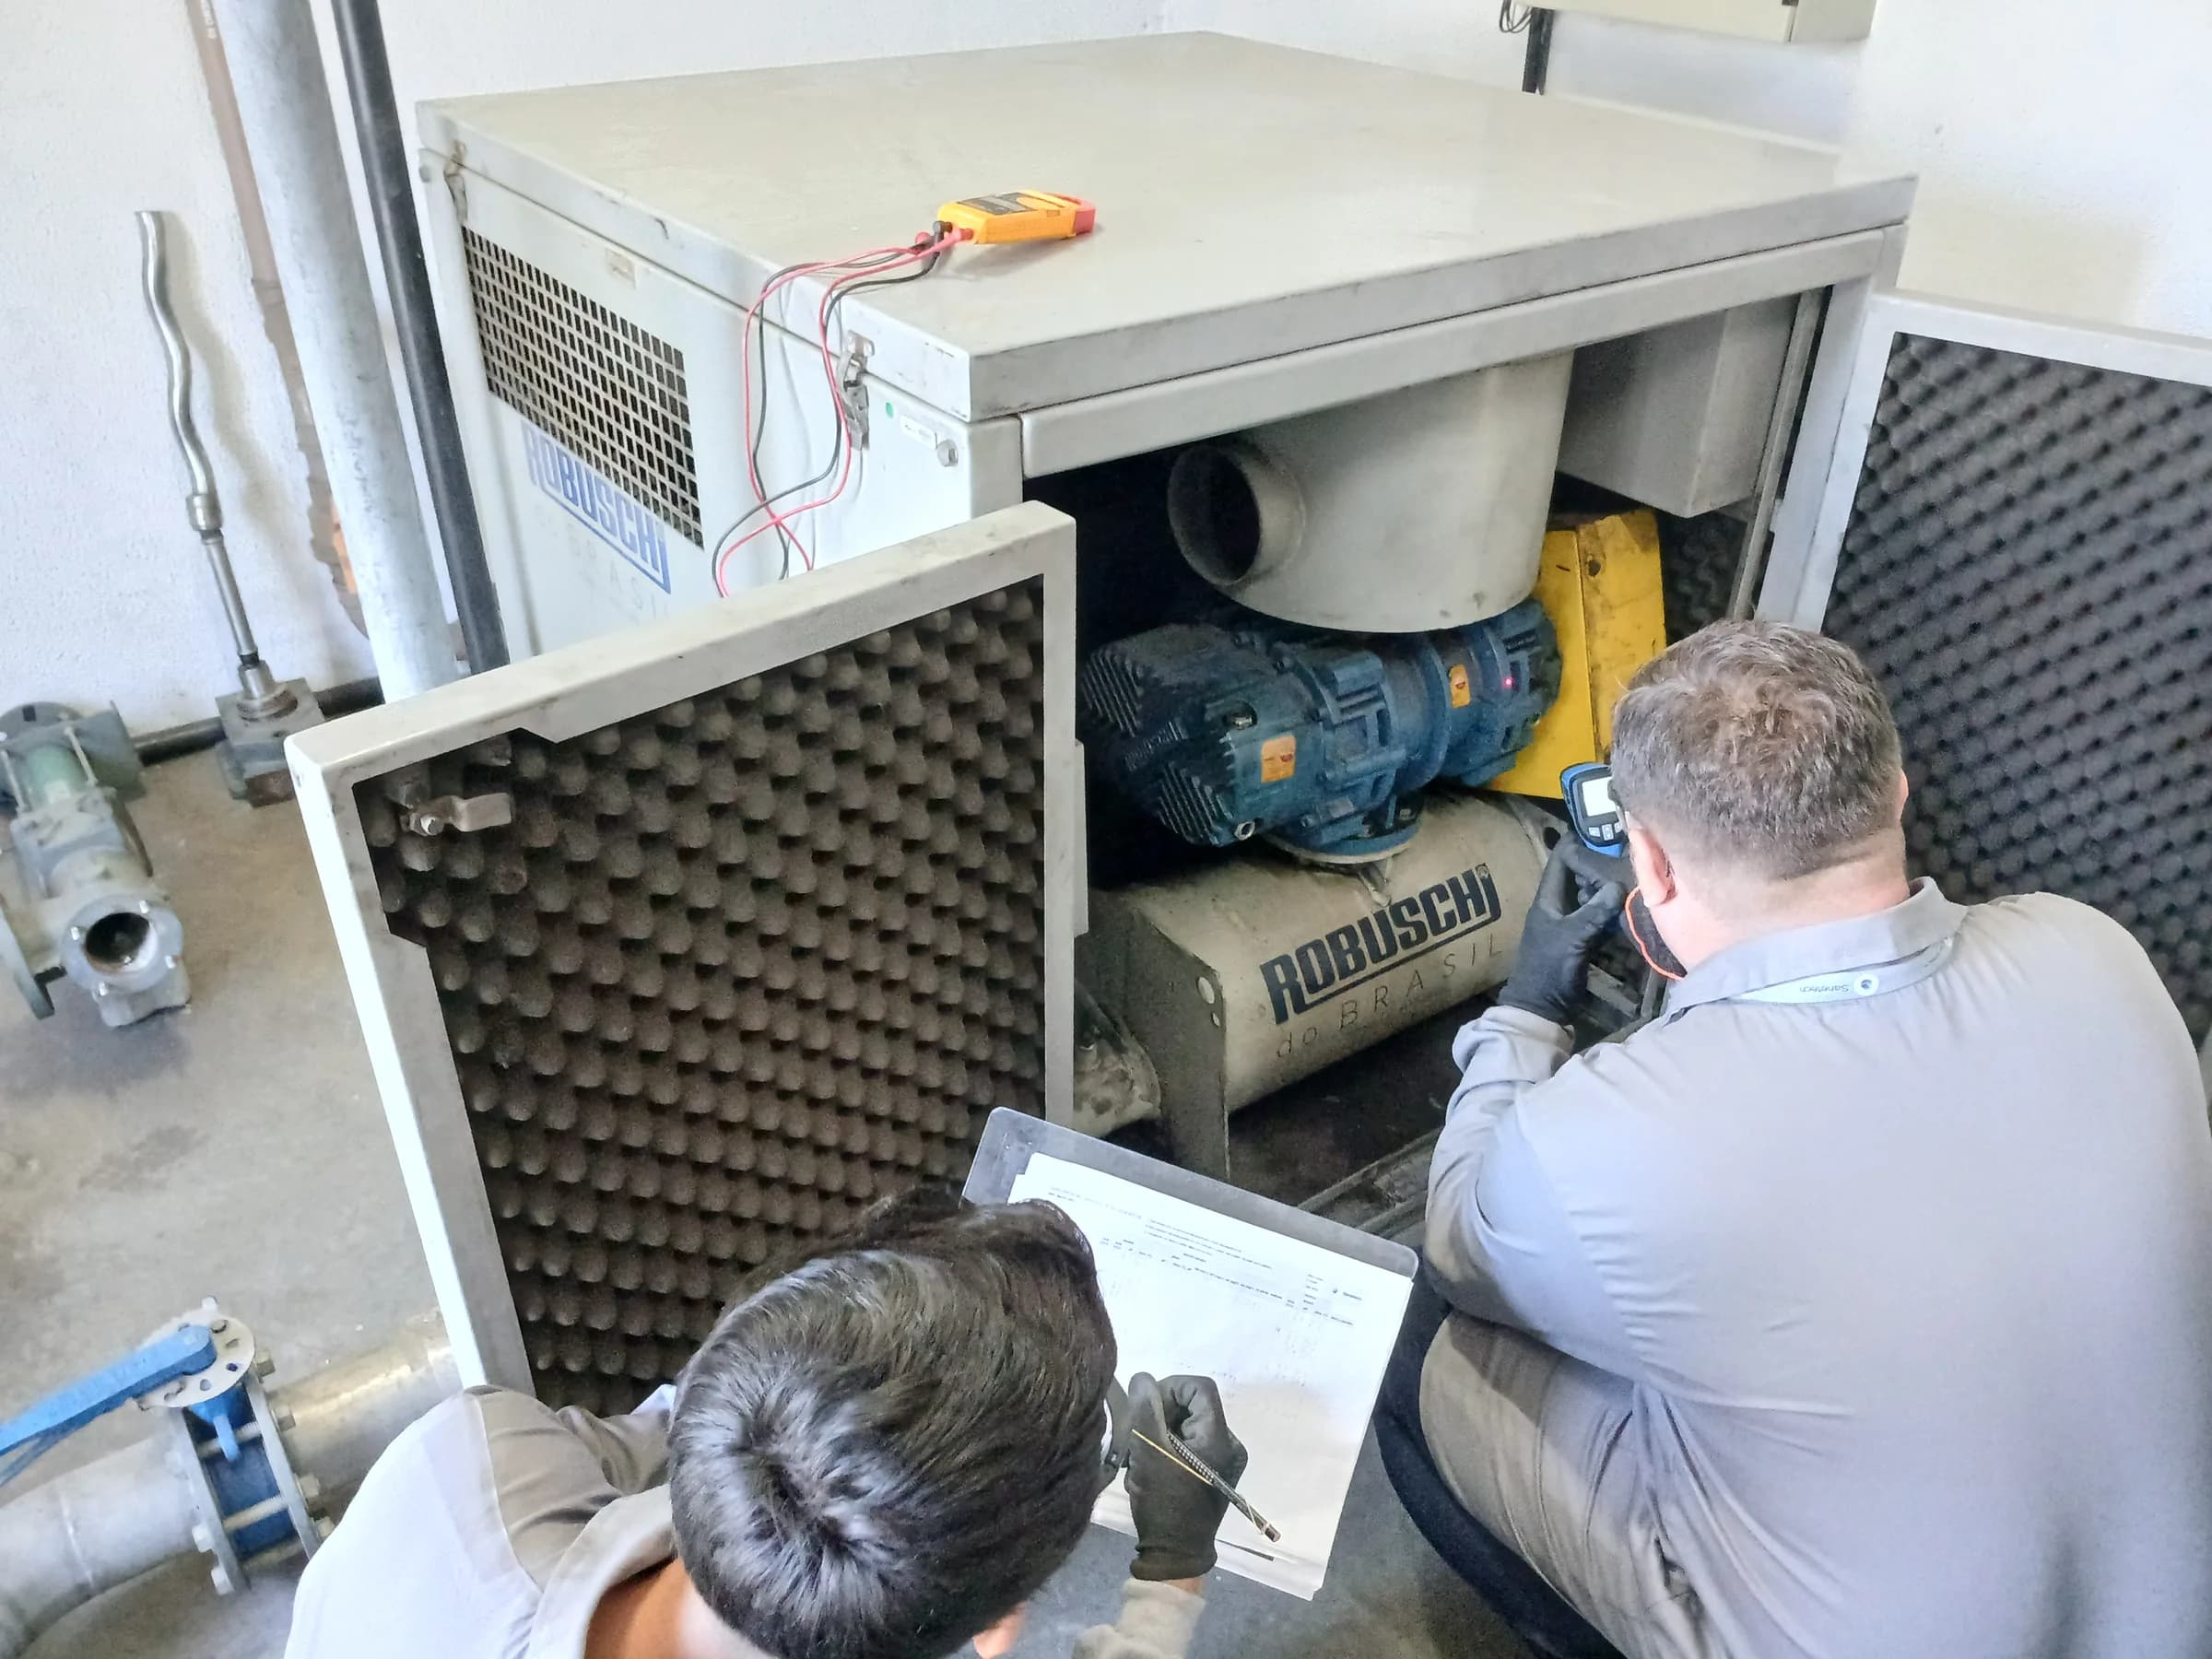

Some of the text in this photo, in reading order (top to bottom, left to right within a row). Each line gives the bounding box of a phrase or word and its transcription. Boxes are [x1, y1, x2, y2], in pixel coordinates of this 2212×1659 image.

[520, 418, 672, 594] ROBUSCHI
[1260, 863, 1502, 1025] ROBUSCHI
[1277, 933, 1502, 1058] do BRASIL
